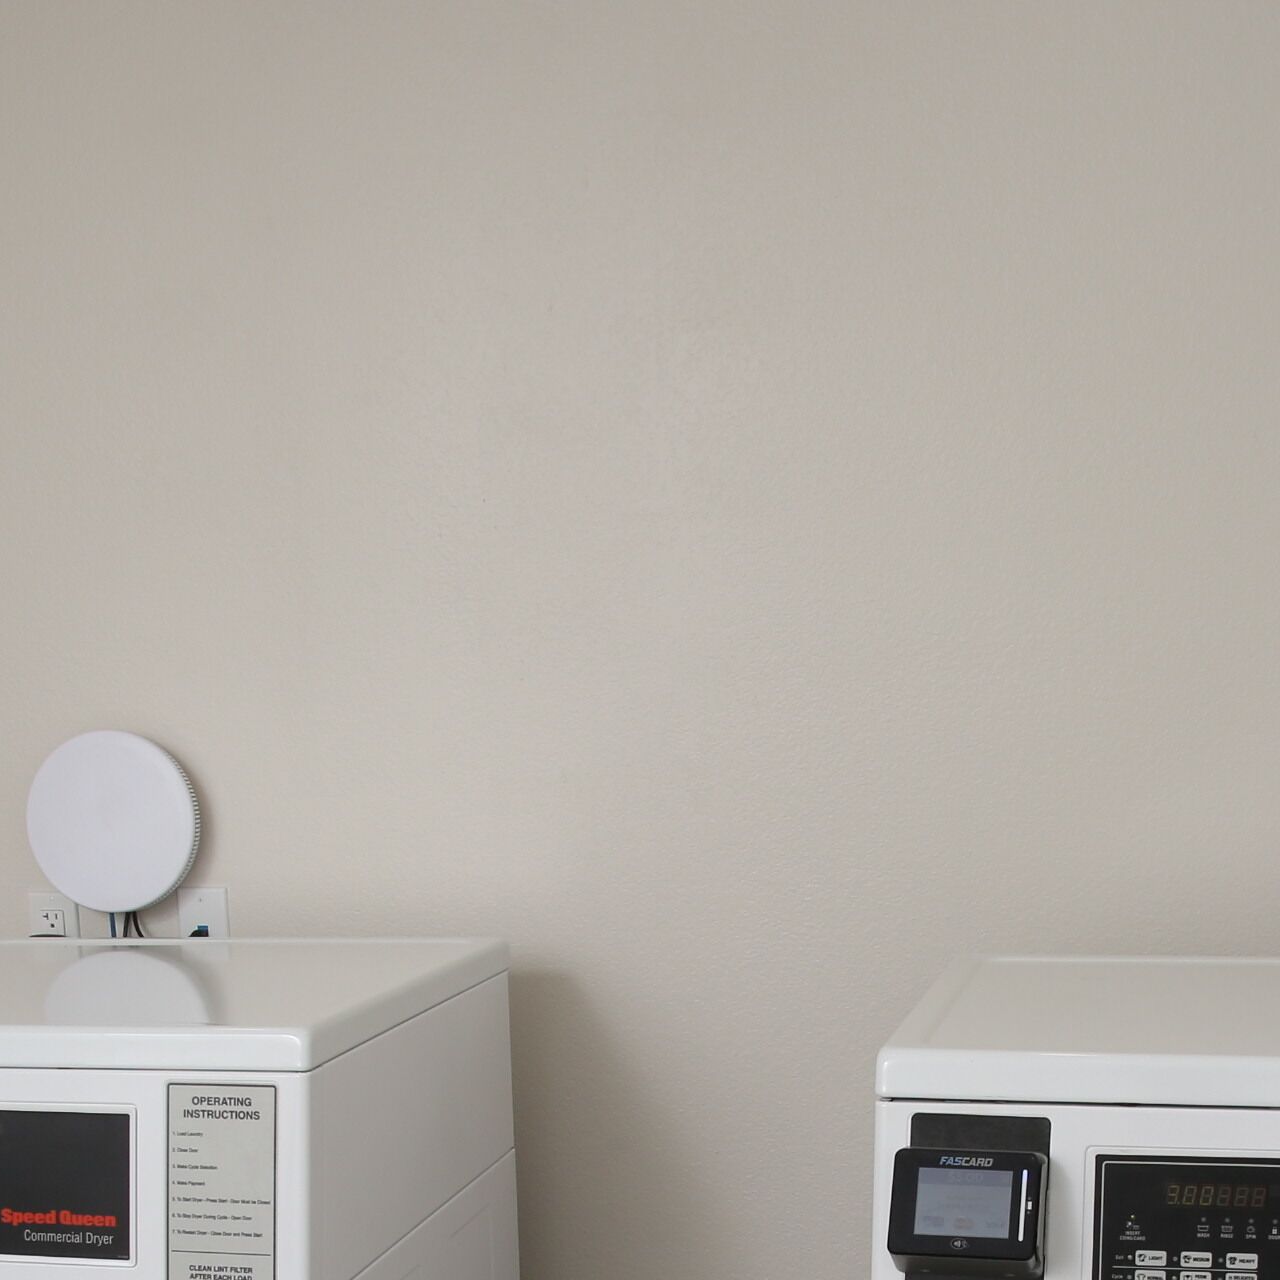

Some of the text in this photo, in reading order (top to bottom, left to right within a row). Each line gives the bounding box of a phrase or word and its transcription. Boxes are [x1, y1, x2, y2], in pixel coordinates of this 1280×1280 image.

[191, 1096, 252, 1107] OPERATING
[183, 1109, 260, 1120] INSTRUCTIONS
[939, 1156, 994, 1167] FASCARD
[1, 1208, 116, 1227] Speed Queen
[24, 1229, 114, 1246] Commercial Dryer
[189, 1264, 253, 1274] CLEAN LINT FILTER
